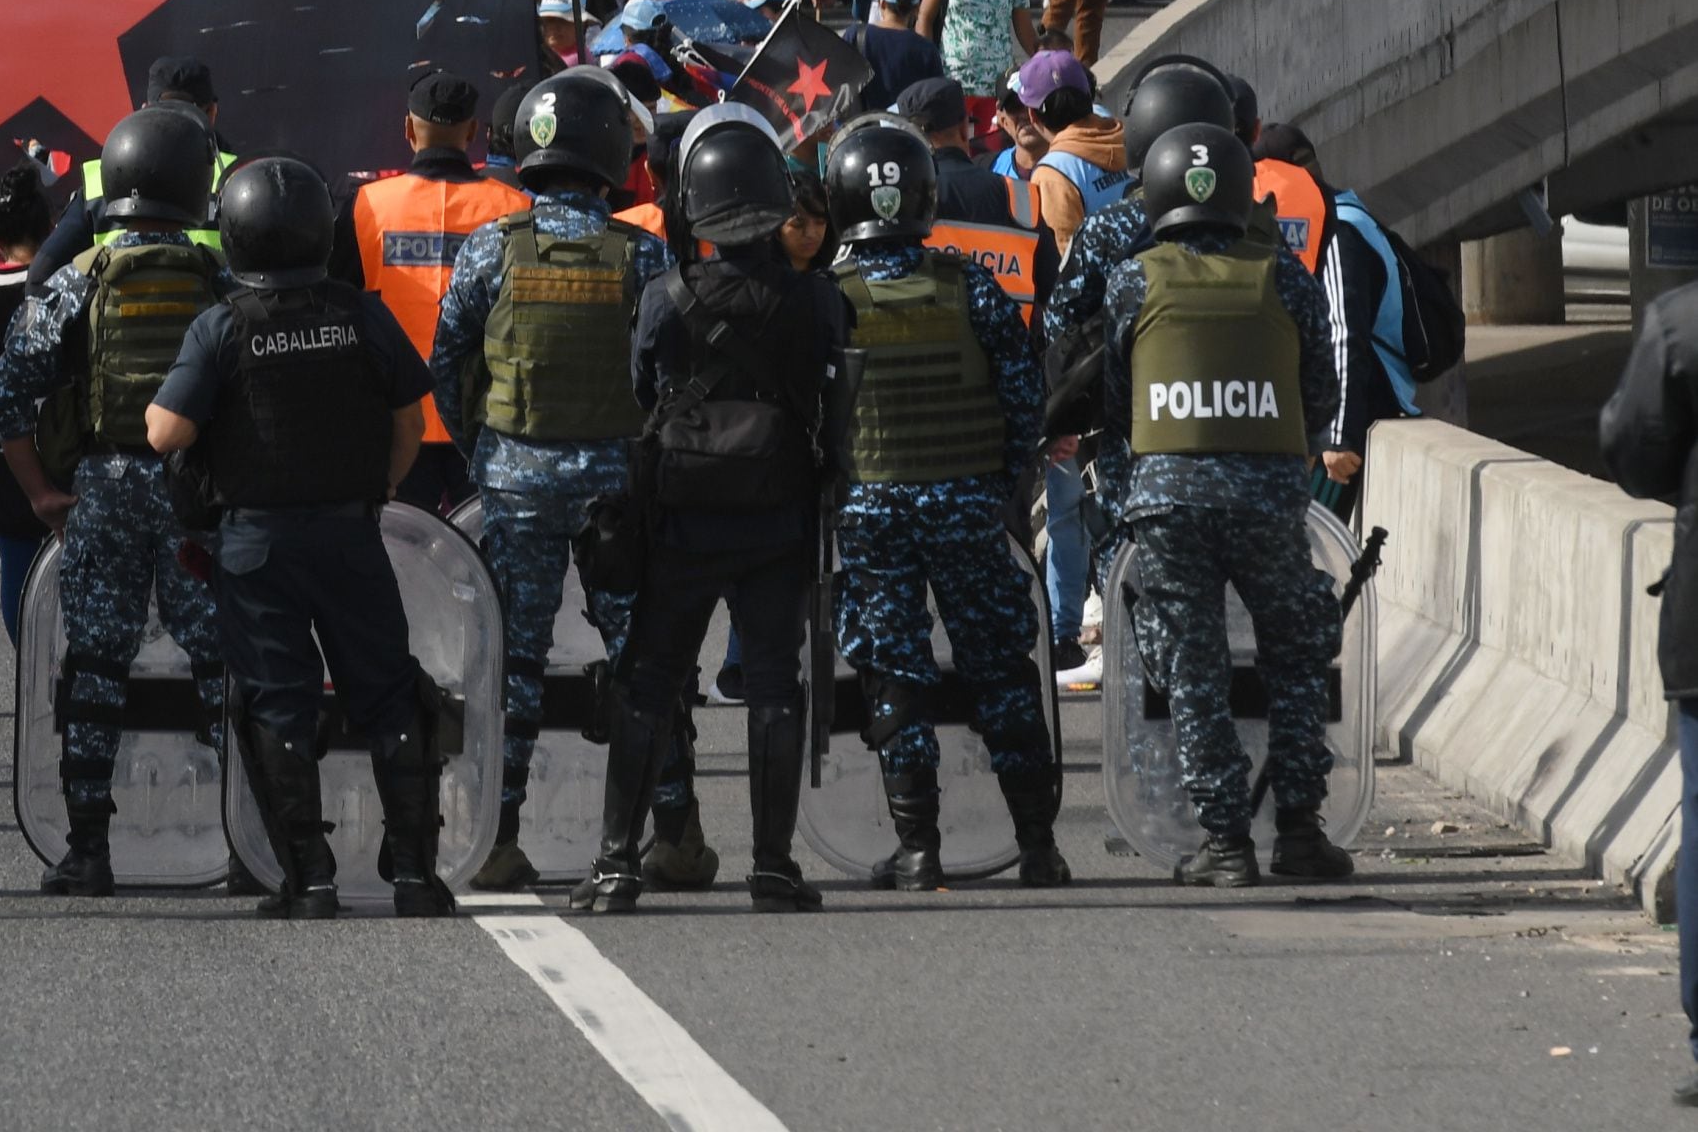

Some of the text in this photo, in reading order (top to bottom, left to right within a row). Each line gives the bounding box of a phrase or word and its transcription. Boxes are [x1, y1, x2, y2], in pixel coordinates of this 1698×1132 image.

[536, 92, 557, 113] 2
[1190, 144, 1210, 167] 3
[867, 160, 901, 187] 19
[252, 325, 359, 357] CABALLERIA
[1149, 380, 1280, 421] POLICIA
